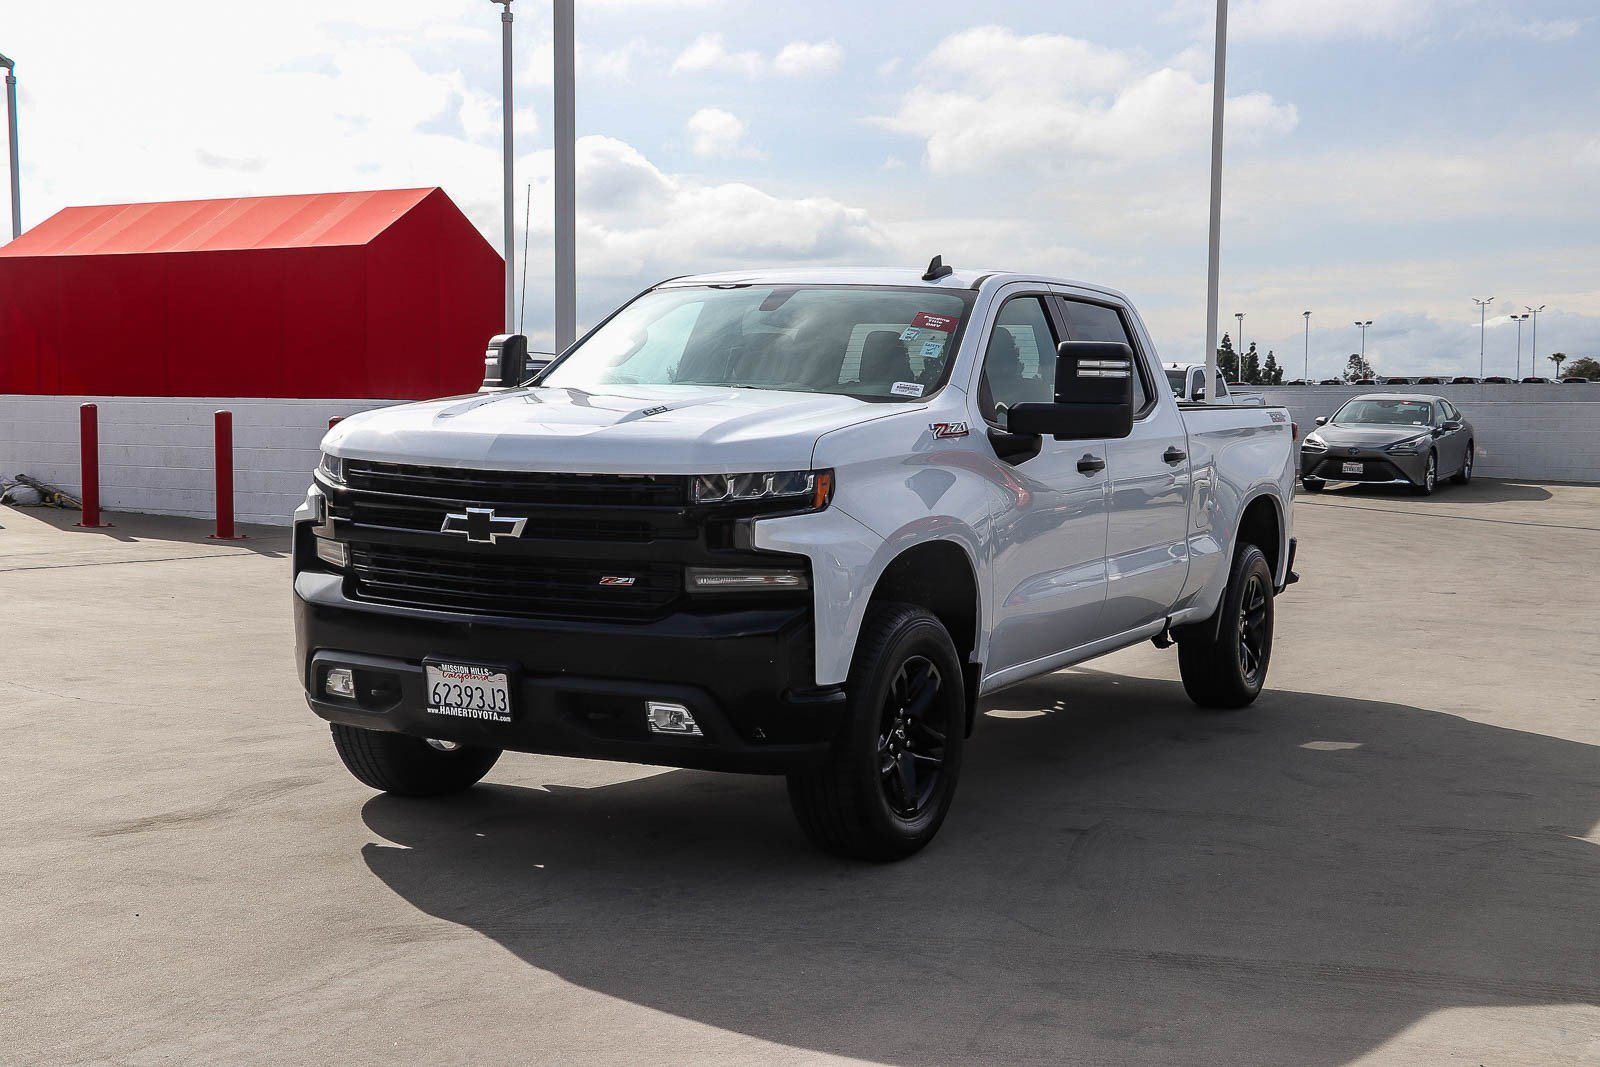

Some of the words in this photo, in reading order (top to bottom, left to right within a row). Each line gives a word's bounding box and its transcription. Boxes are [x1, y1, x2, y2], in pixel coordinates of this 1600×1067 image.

[923, 315, 950, 323] Pending
[441, 663, 469, 675] MISSION
[470, 667, 490, 676] HILLS
[432, 682, 507, 712] 62393J3
[426, 705, 512, 722] www.HAMERTOYOTA.com
